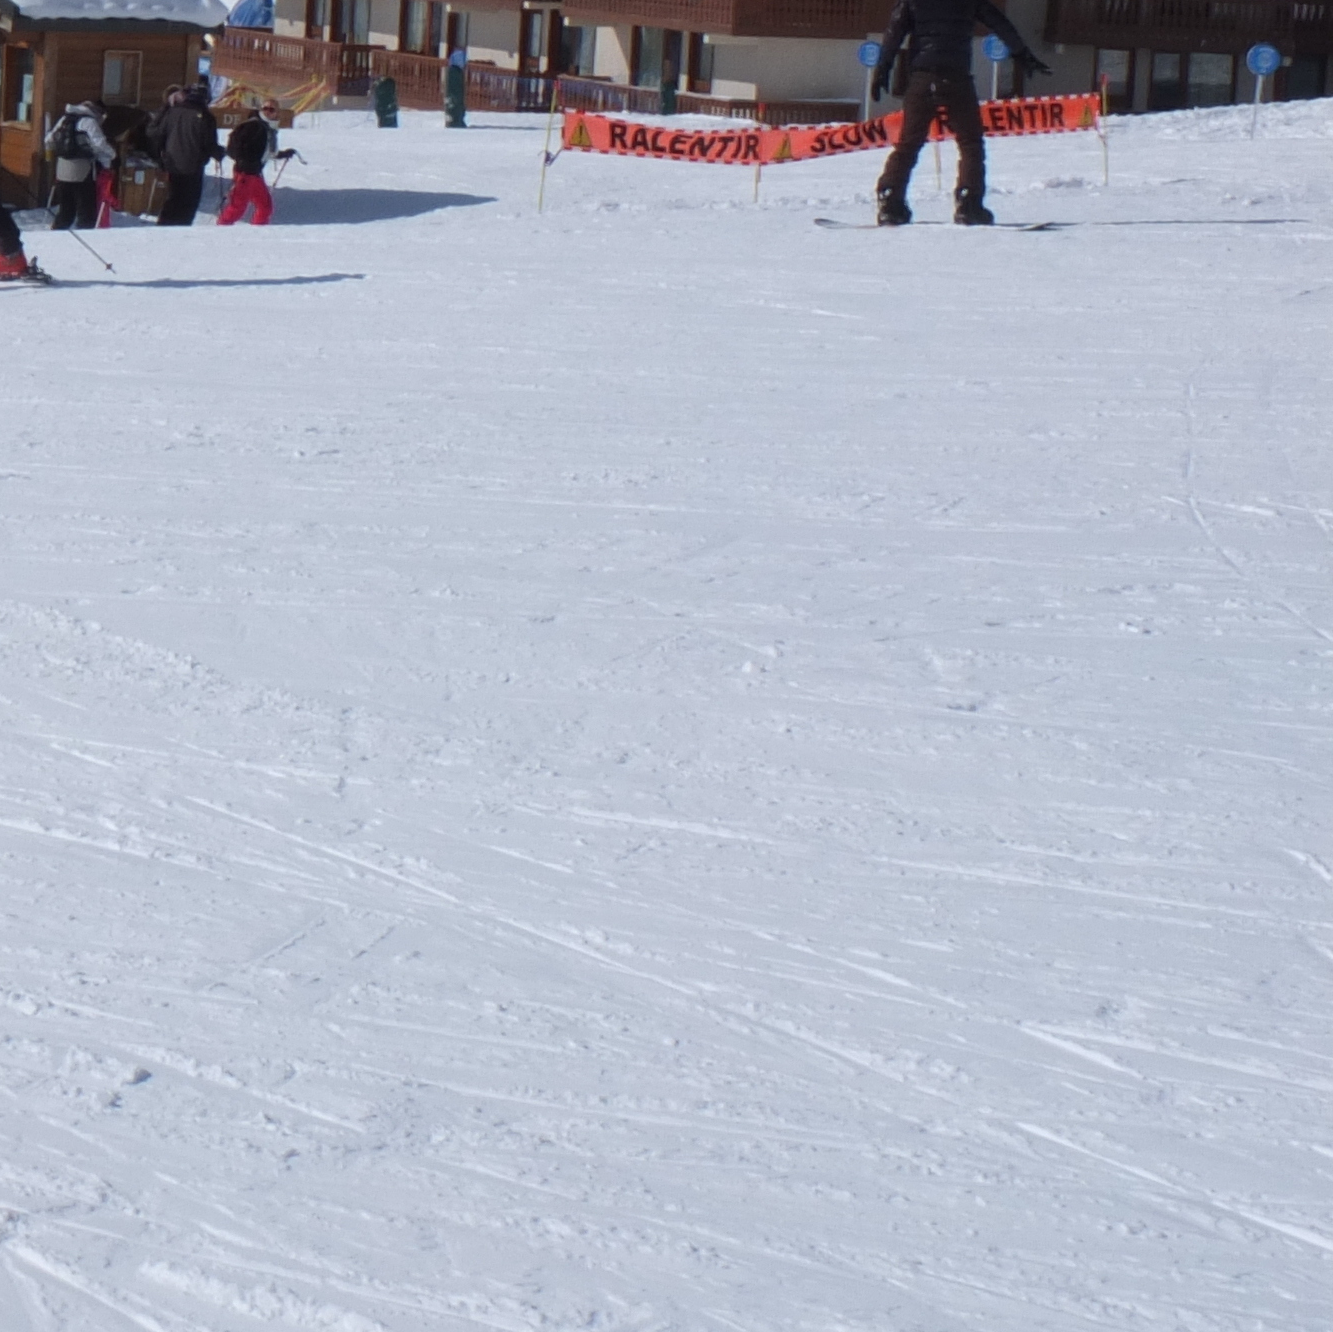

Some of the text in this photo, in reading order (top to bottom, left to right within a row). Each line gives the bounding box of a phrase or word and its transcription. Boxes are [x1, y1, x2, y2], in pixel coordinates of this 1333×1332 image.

[810, 118, 888, 153] SLOW
[935, 103, 1065, 136] RENTIR
[609, 122, 760, 160] RALENTIR
